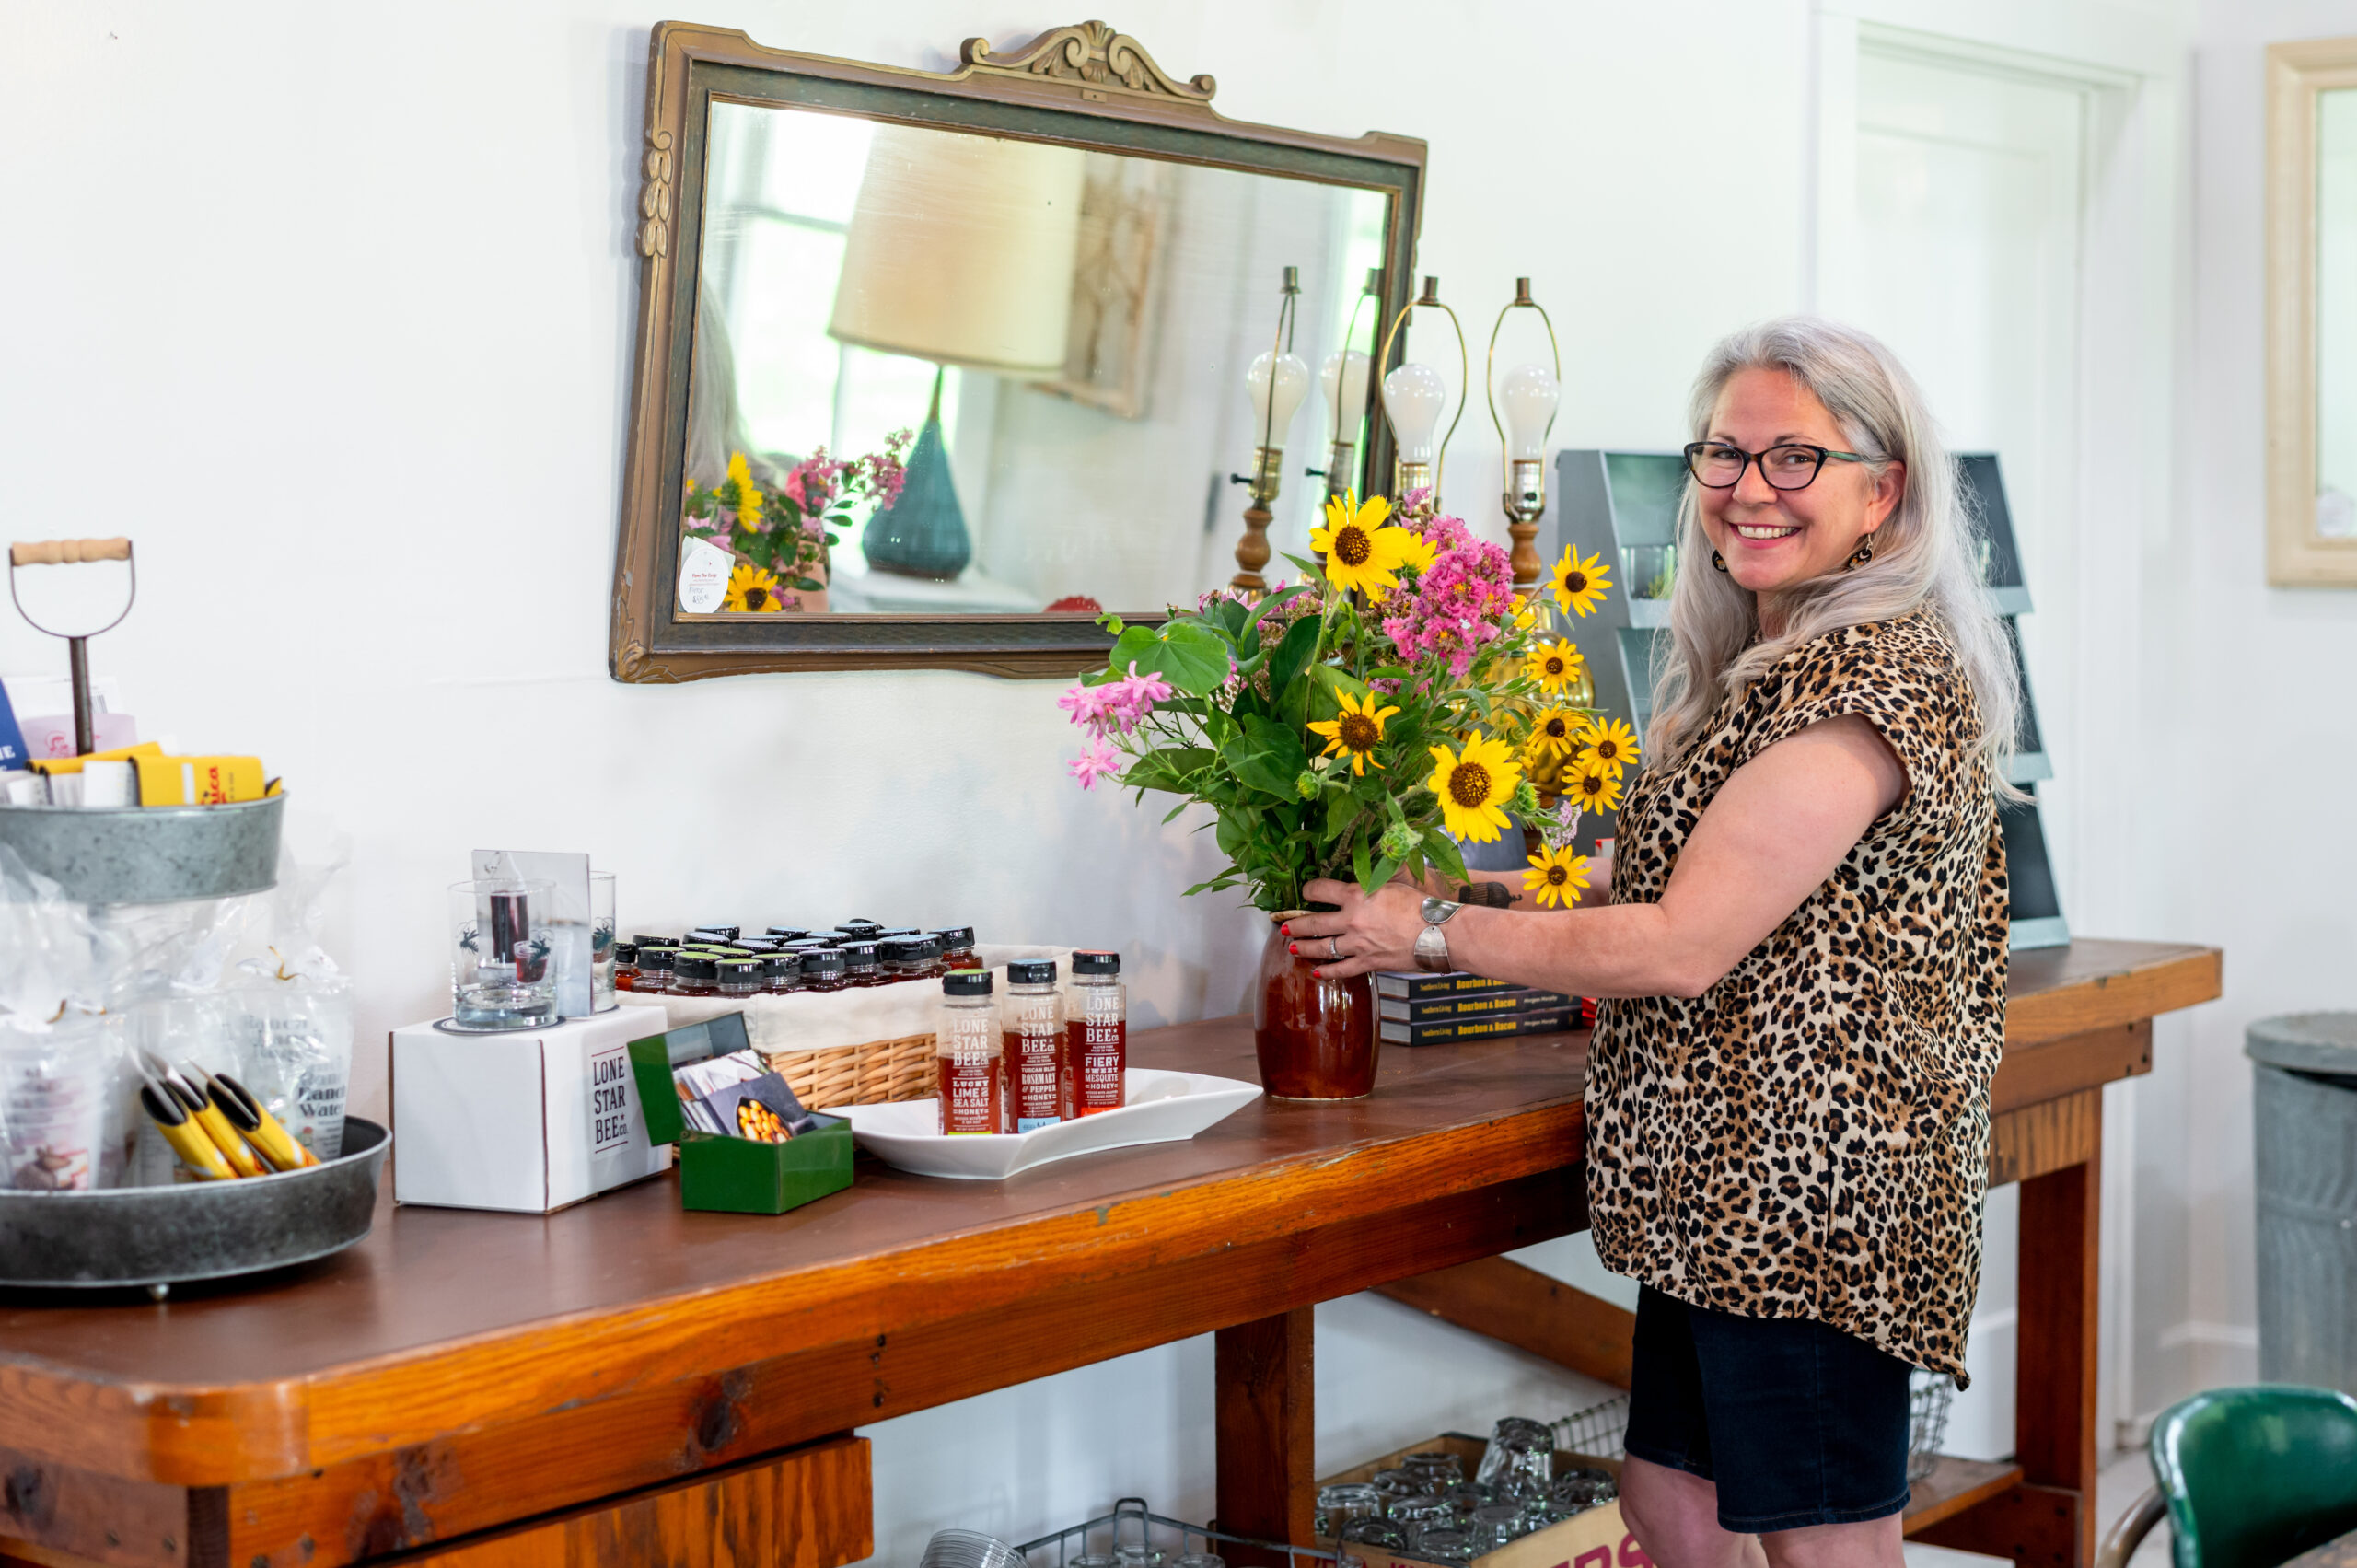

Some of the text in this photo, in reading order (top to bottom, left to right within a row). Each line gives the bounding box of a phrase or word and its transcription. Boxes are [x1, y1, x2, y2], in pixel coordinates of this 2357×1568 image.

[1457, 978, 1486, 990] Bourbon
[1086, 997, 1119, 1011] LONE
[1457, 1001, 1488, 1012] Bourbon
[1488, 1001, 1493, 1009] &
[1494, 998, 1516, 1009] Bacon
[1021, 1006, 1054, 1020] LONE
[1086, 1013, 1119, 1027] STAR
[953, 1018, 988, 1033] LONE
[1021, 1023, 1054, 1037] STAR
[1457, 1025, 1488, 1036] Bourbon
[1489, 1024, 1493, 1032] &
[1494, 1021, 1516, 1031] Bacon
[1086, 1028, 1111, 1042] BEE
[953, 1035, 988, 1050] STAR
[1021, 1039, 1047, 1053] BEE
[953, 1051, 981, 1066] BEE
[1086, 1056, 1119, 1067] FIERY
[593, 1056, 625, 1086] LONE
[1085, 1074, 1119, 1082] MESQUITE
[1021, 1073, 1056, 1085] ROSEMARY
[953, 1087, 980, 1098] LIME
[1030, 1084, 1057, 1093] PEPPER
[594, 1085, 626, 1115] STAR
[953, 1097, 989, 1108] SEA SALT
[1028, 1093, 1051, 1101] HONEY
[958, 1108, 984, 1116] HONEY
[595, 1115, 620, 1144] BEE
